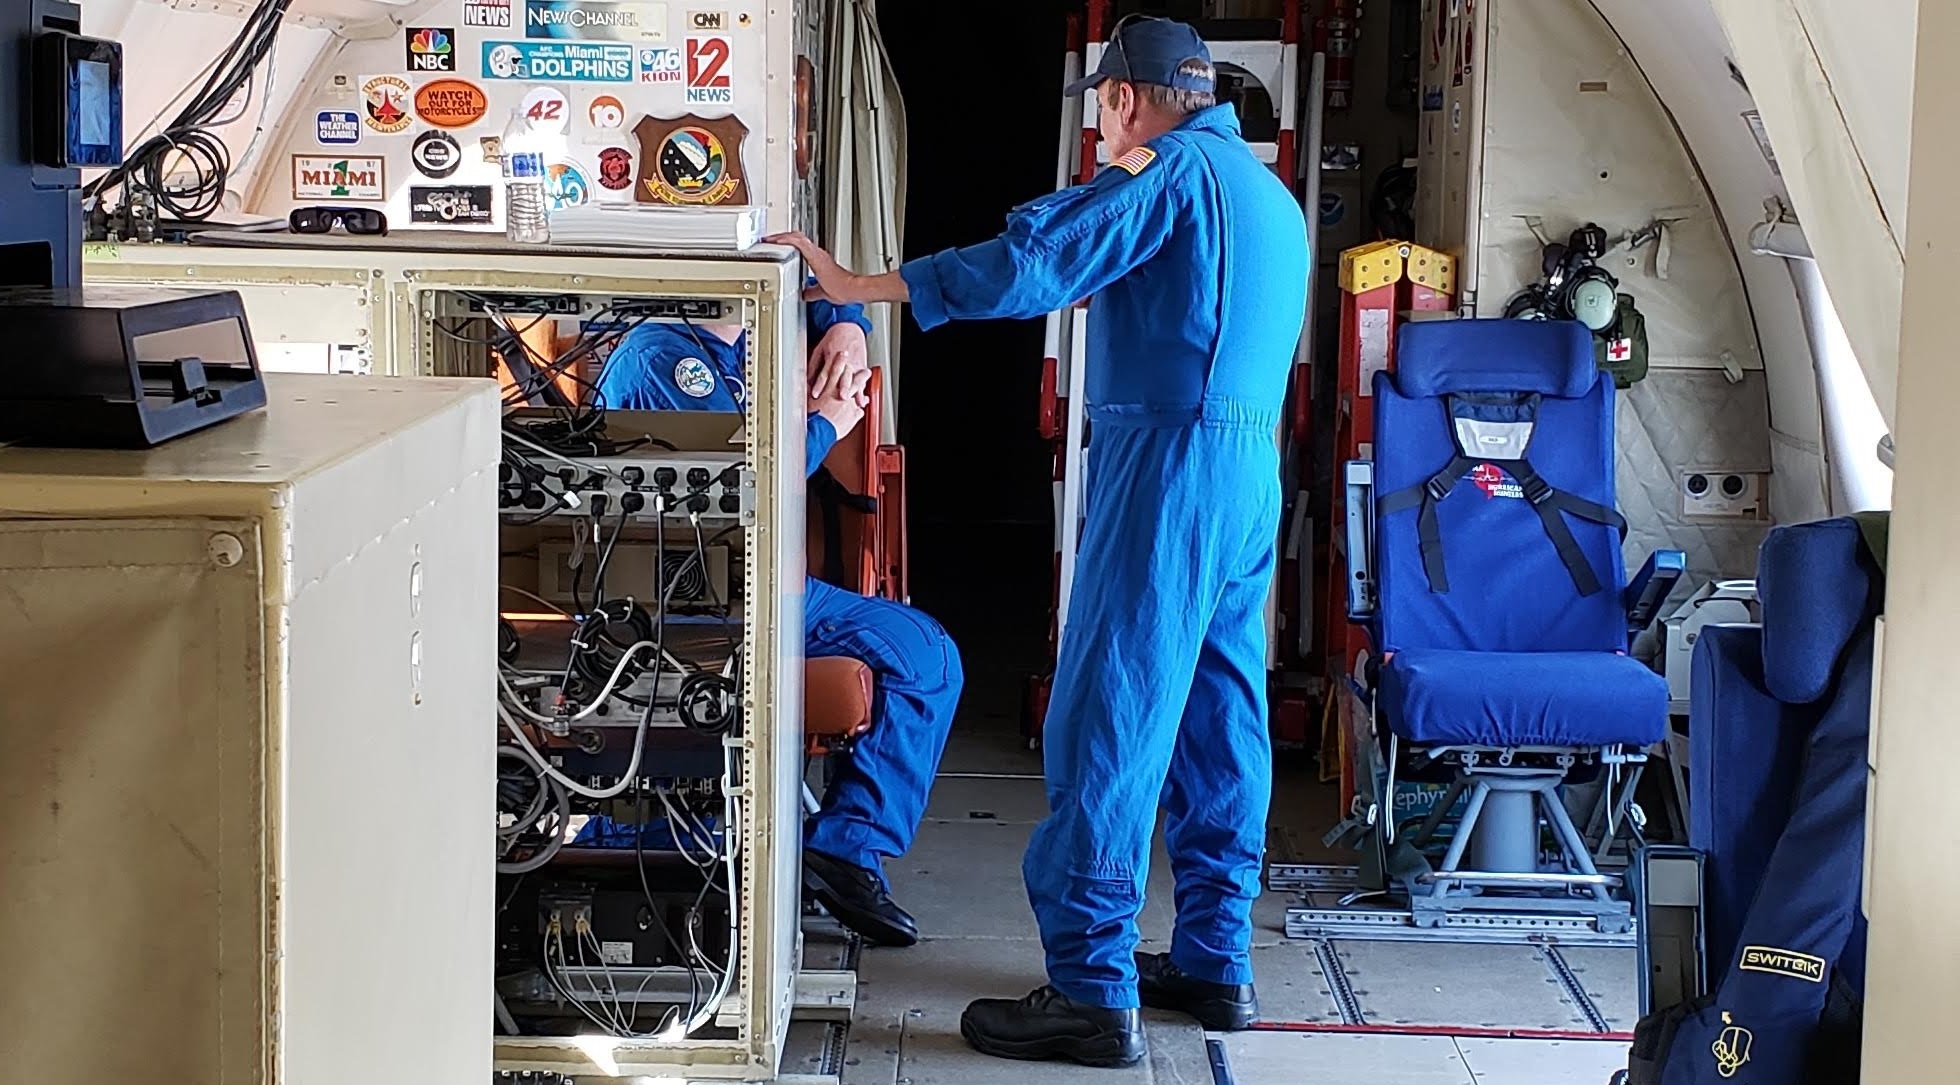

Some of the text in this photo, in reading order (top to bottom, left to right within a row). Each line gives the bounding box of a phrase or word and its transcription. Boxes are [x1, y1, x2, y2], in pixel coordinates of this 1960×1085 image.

[466, 5, 509, 26] NEWS
[693, 13, 720, 26] CNN
[565, 45, 603, 59] Miami
[413, 55, 449, 70] NBC
[652, 48, 680, 71] 46
[686, 38, 729, 87] 12
[531, 59, 629, 78] DOLPHINS
[641, 72, 681, 82] KION
[428, 91, 472, 100] WATCH
[687, 89, 730, 102] NEWS
[429, 100, 448, 108] OUT
[527, 100, 563, 121] 42
[330, 114, 346, 122] THE
[592, 105, 624, 128] 10
[319, 121, 357, 131] WEATHER
[320, 131, 356, 139] CHANNEL
[302, 170, 376, 186] MIAMI
